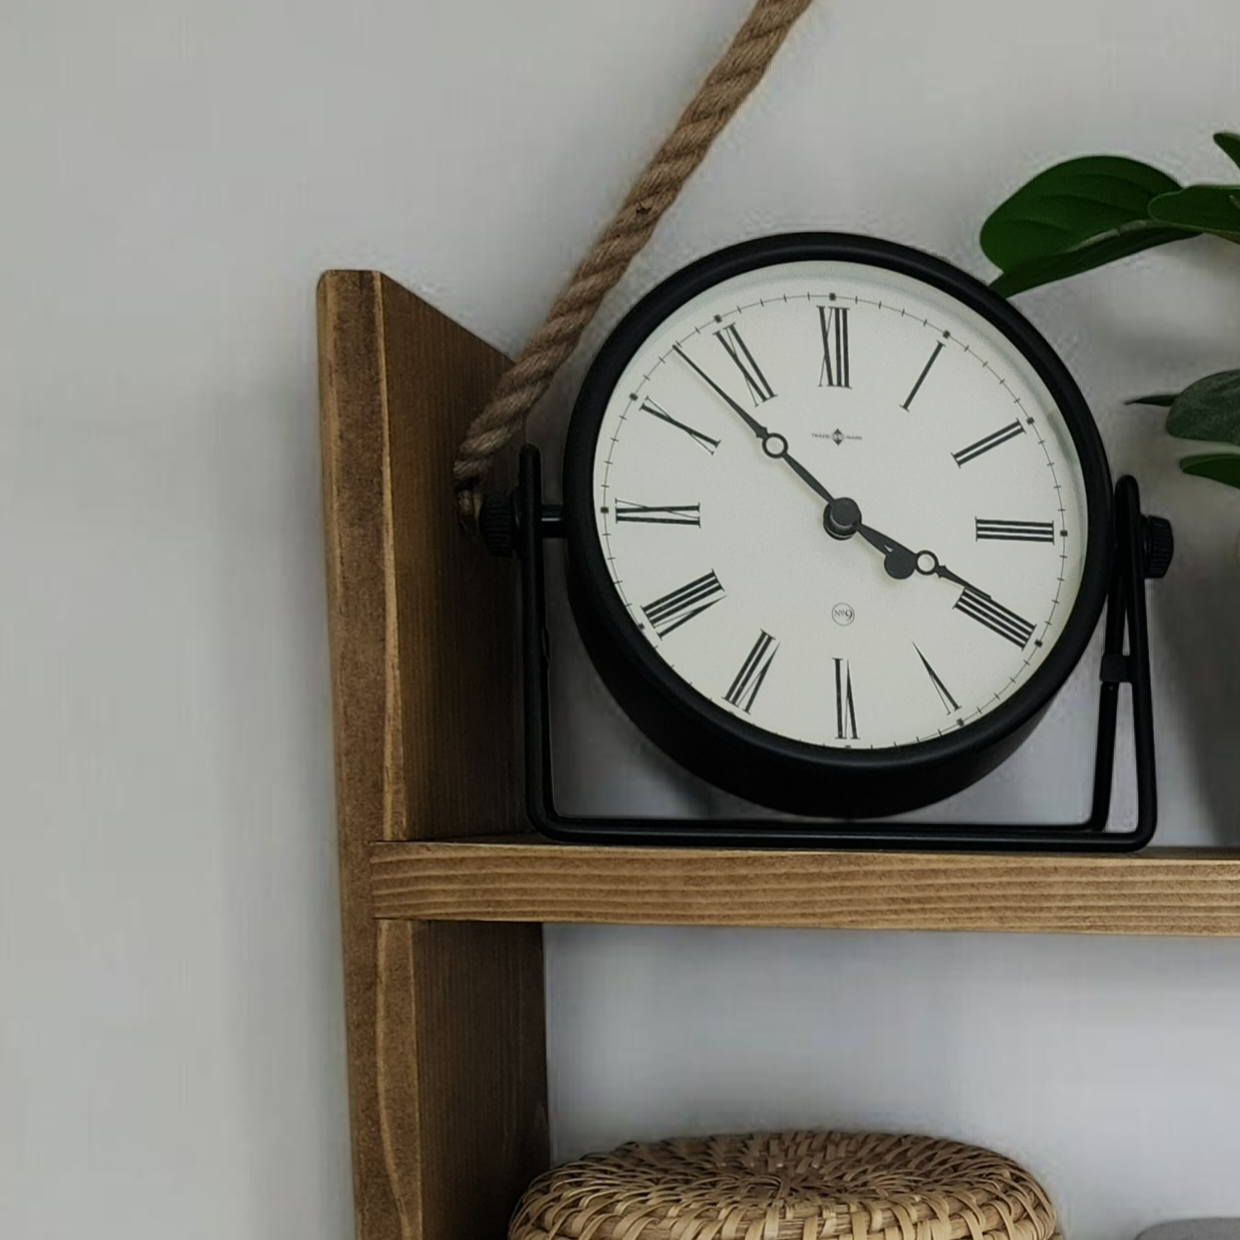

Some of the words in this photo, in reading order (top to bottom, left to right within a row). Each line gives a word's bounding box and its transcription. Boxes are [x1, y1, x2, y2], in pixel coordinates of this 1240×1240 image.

[711, 322, 778, 408] XI
[816, 304, 852, 389] XII
[638, 396, 722, 456] X
[950, 418, 1027, 469] II
[613, 497, 702, 529] IX
[974, 516, 1055, 545] III
[723, 629, 781, 714] VII
[831, 657, 860, 740] VI
[912, 640, 962, 716] V
